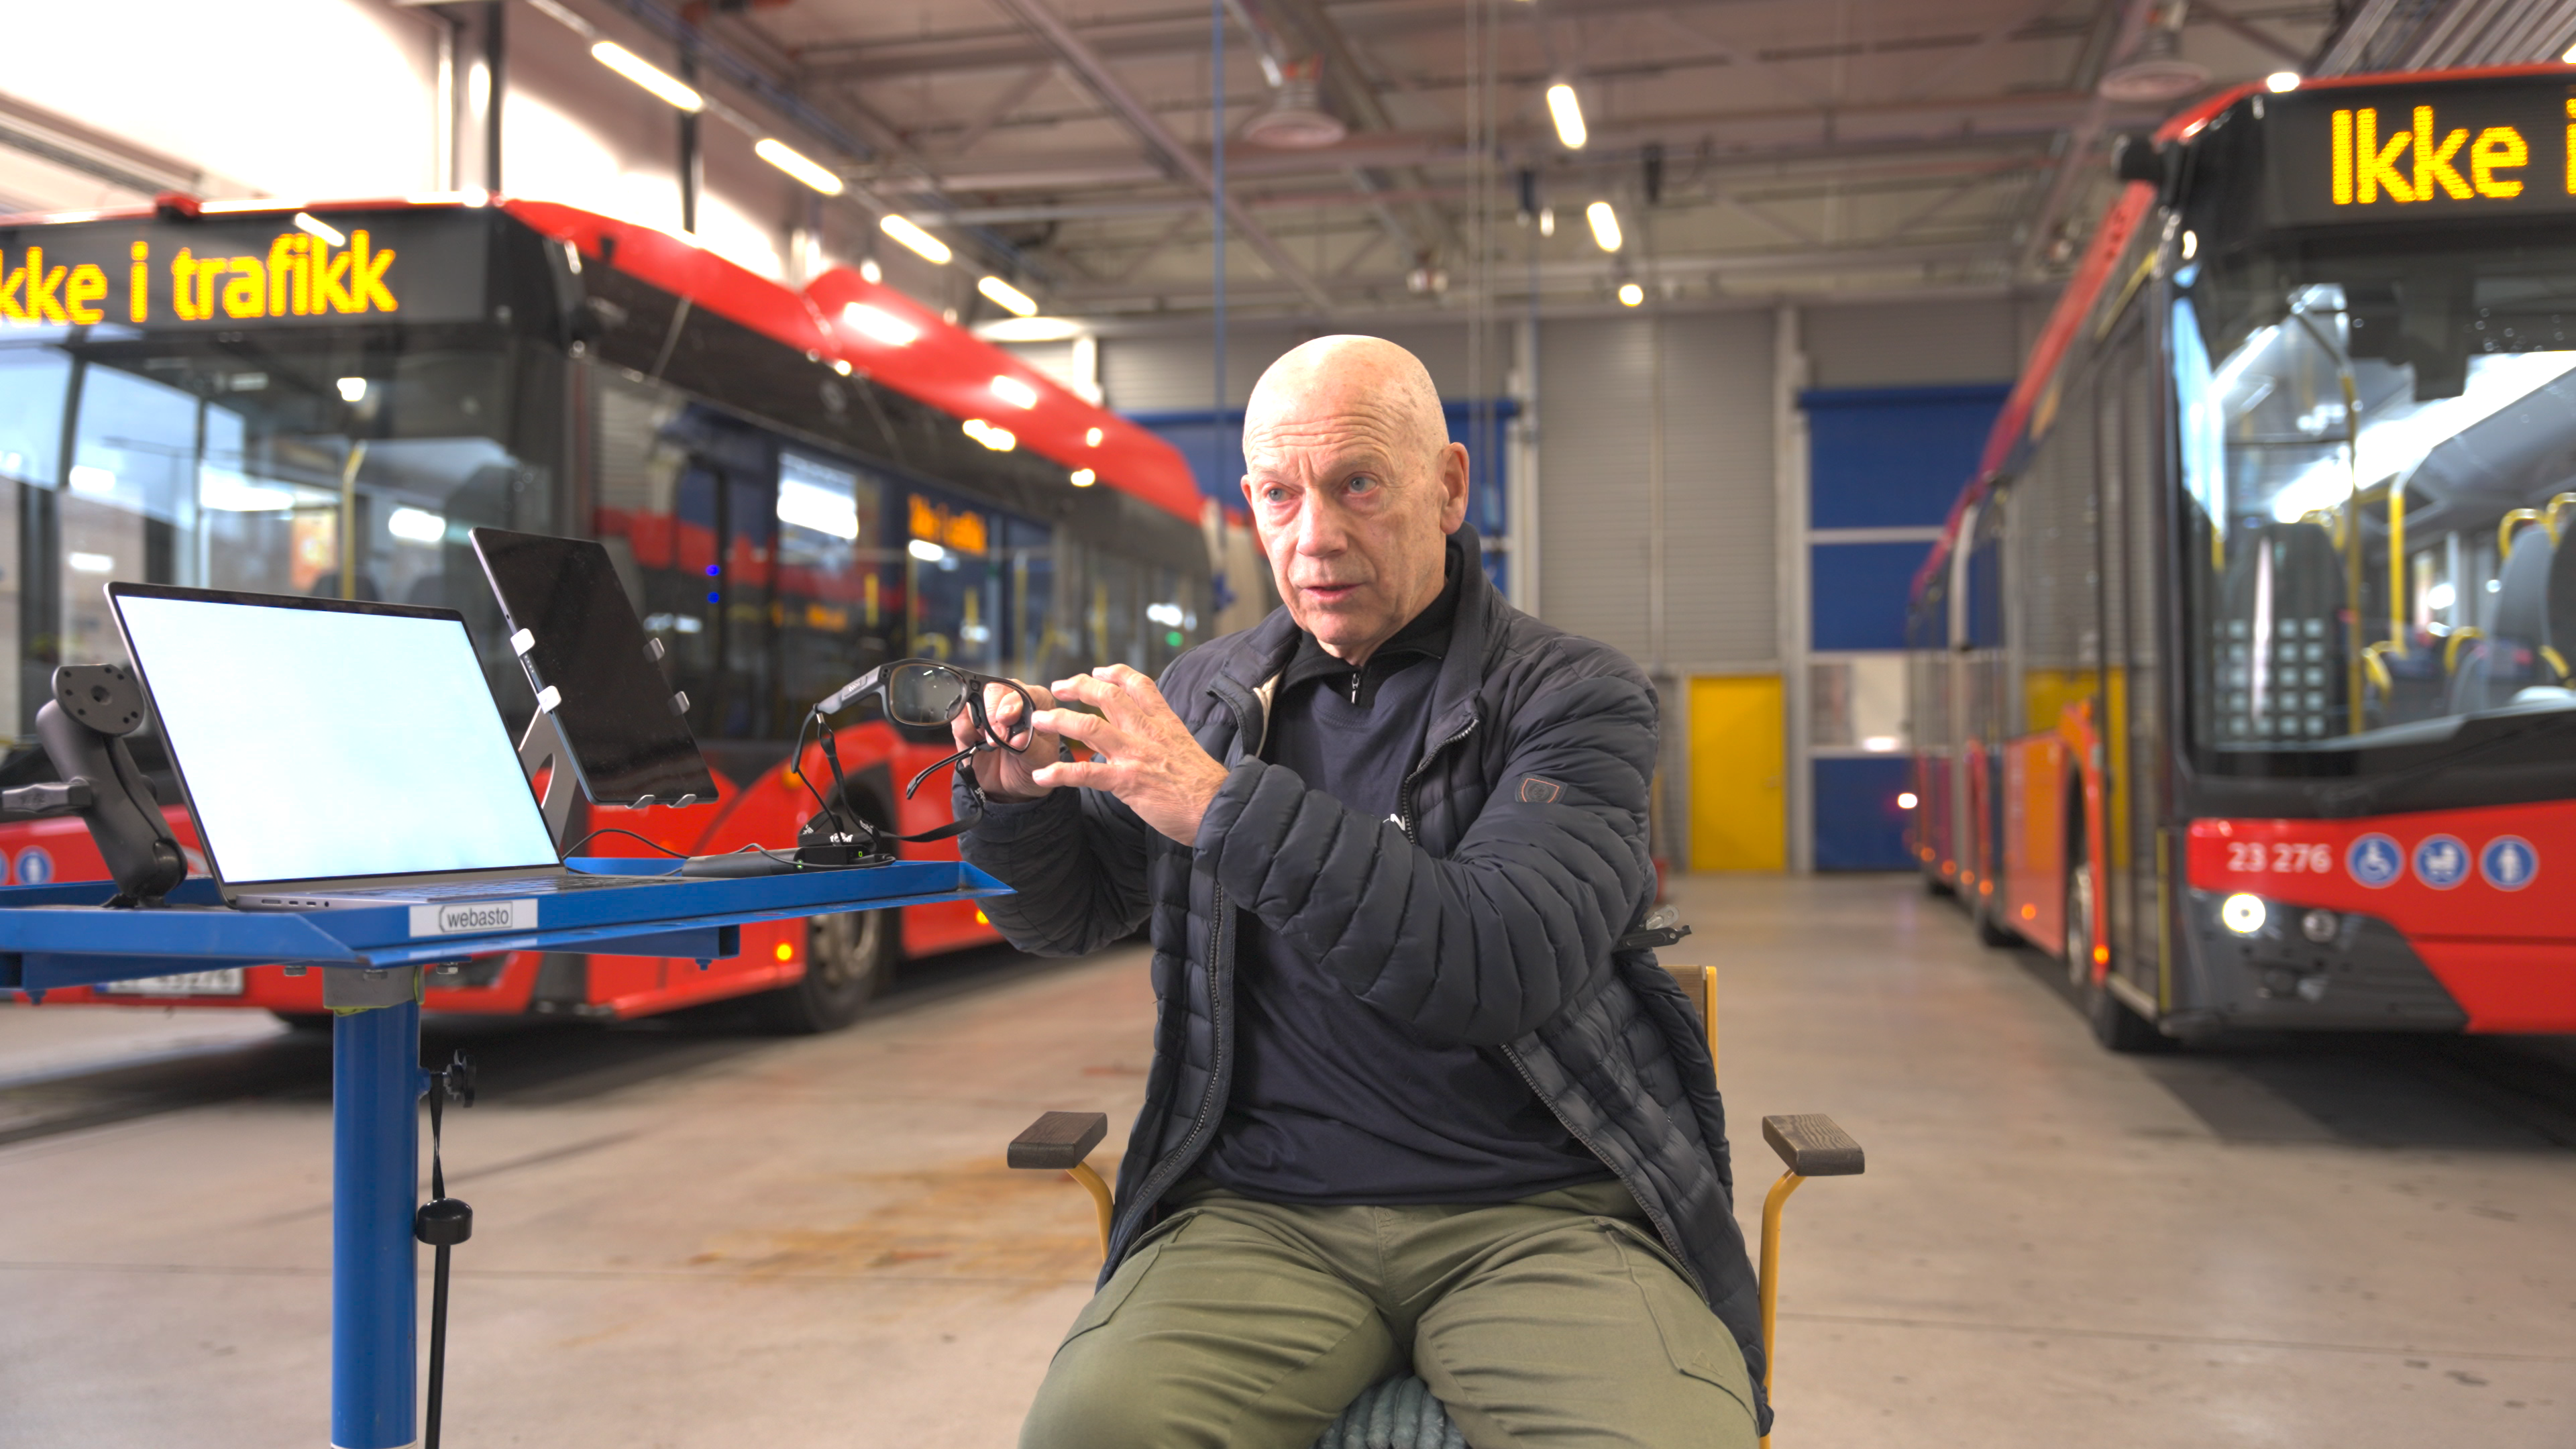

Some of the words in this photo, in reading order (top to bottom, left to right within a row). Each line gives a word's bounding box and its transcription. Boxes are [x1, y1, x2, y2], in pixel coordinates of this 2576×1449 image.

[2331, 105, 2528, 204] Ikke
[2566, 98, 2576, 194] i
[130, 241, 148, 323] i
[172, 229, 398, 320] trafikk
[2226, 842, 2267, 872] 23
[2273, 843, 2332, 873] 276
[447, 908, 509, 928] webasto
